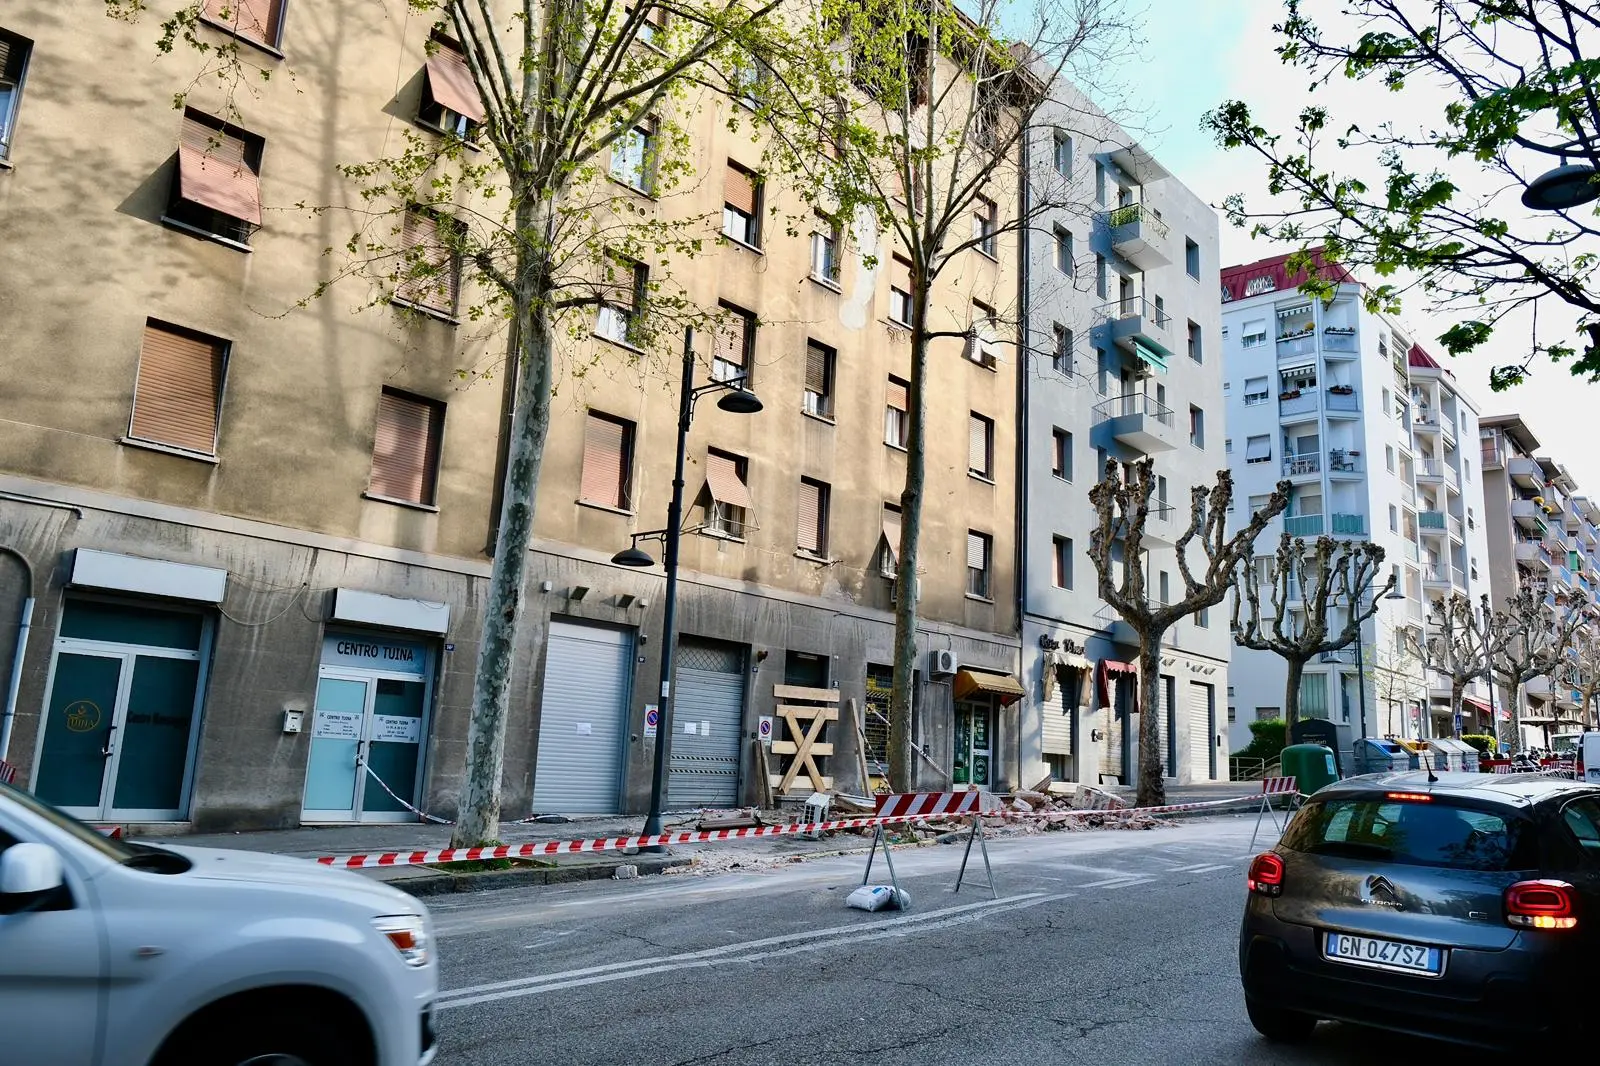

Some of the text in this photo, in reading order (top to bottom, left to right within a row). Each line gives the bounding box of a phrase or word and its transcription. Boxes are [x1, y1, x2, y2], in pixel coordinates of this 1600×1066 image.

[337, 641, 414, 661] CENTRO TUINA
[1339, 936, 1425, 967] GN 047SZ
